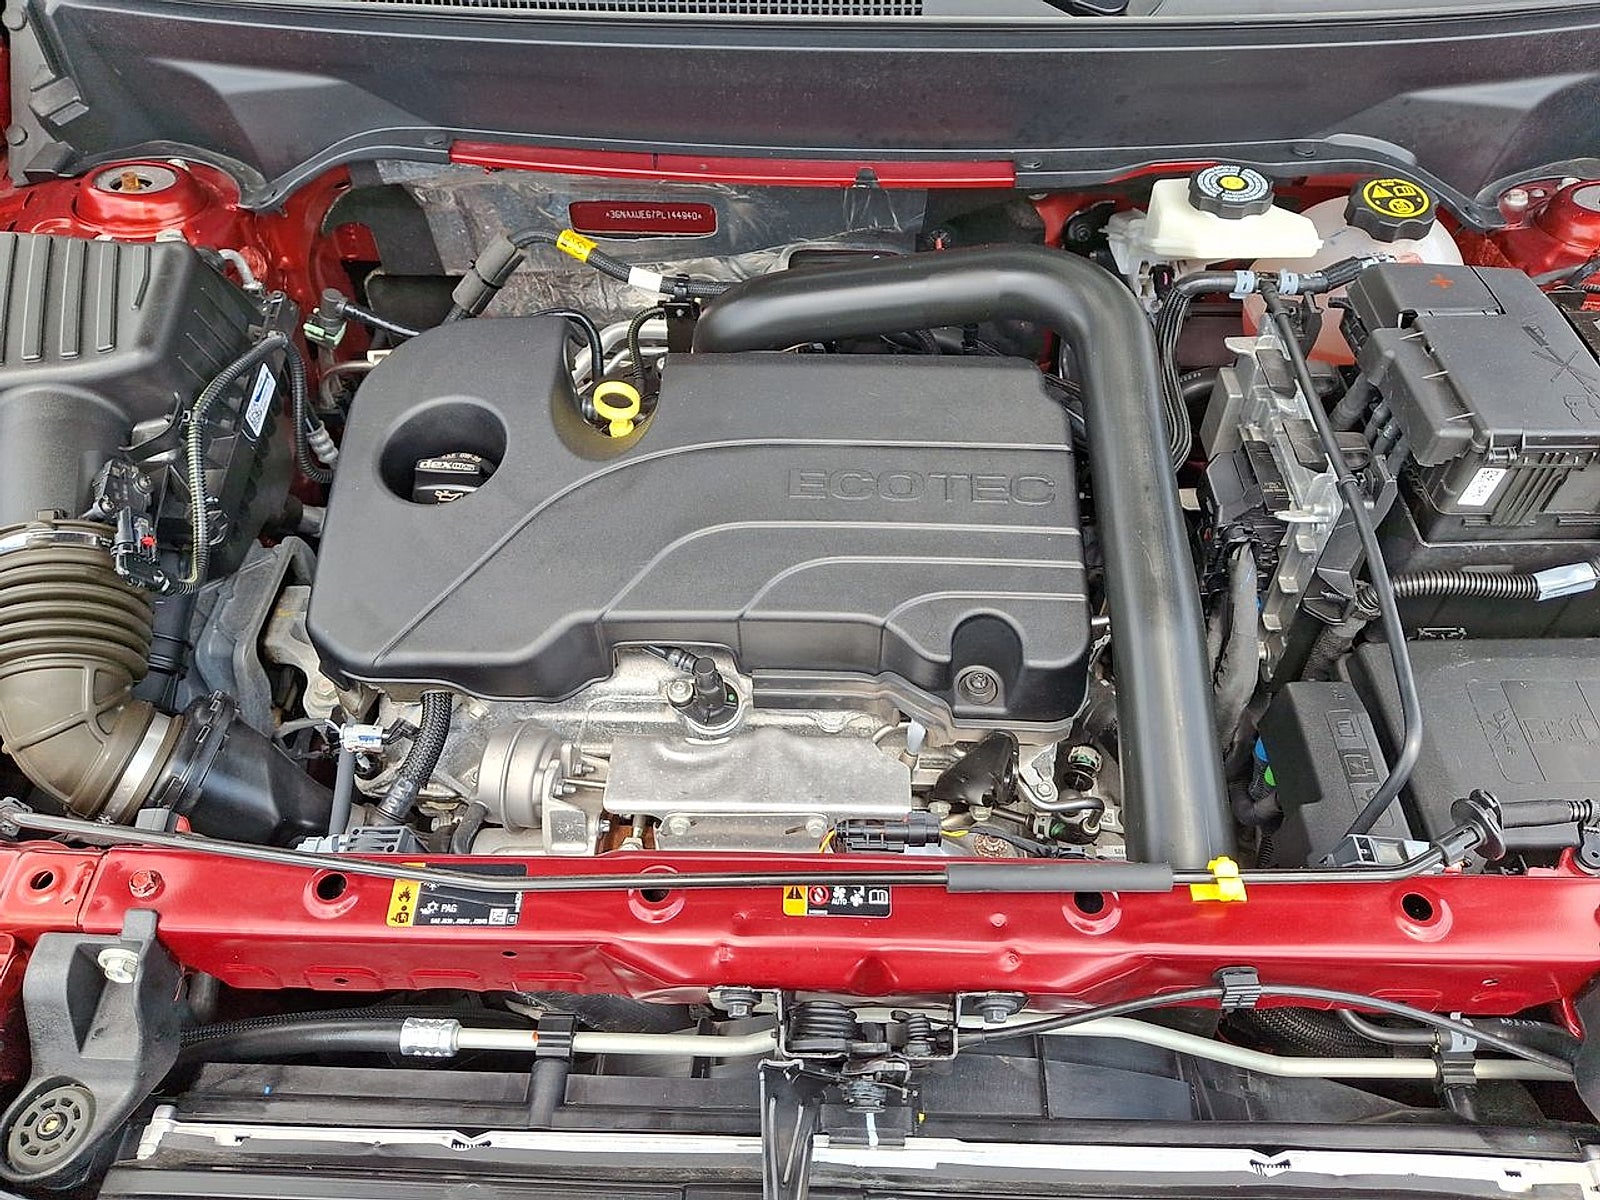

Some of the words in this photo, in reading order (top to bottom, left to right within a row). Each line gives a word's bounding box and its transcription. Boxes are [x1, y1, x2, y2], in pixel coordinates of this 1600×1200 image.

[419, 459, 475, 471] dexos
[788, 468, 1057, 507] ECOTEC
[831, 898, 848, 906] AUTO
[440, 903, 458, 914] PAG
